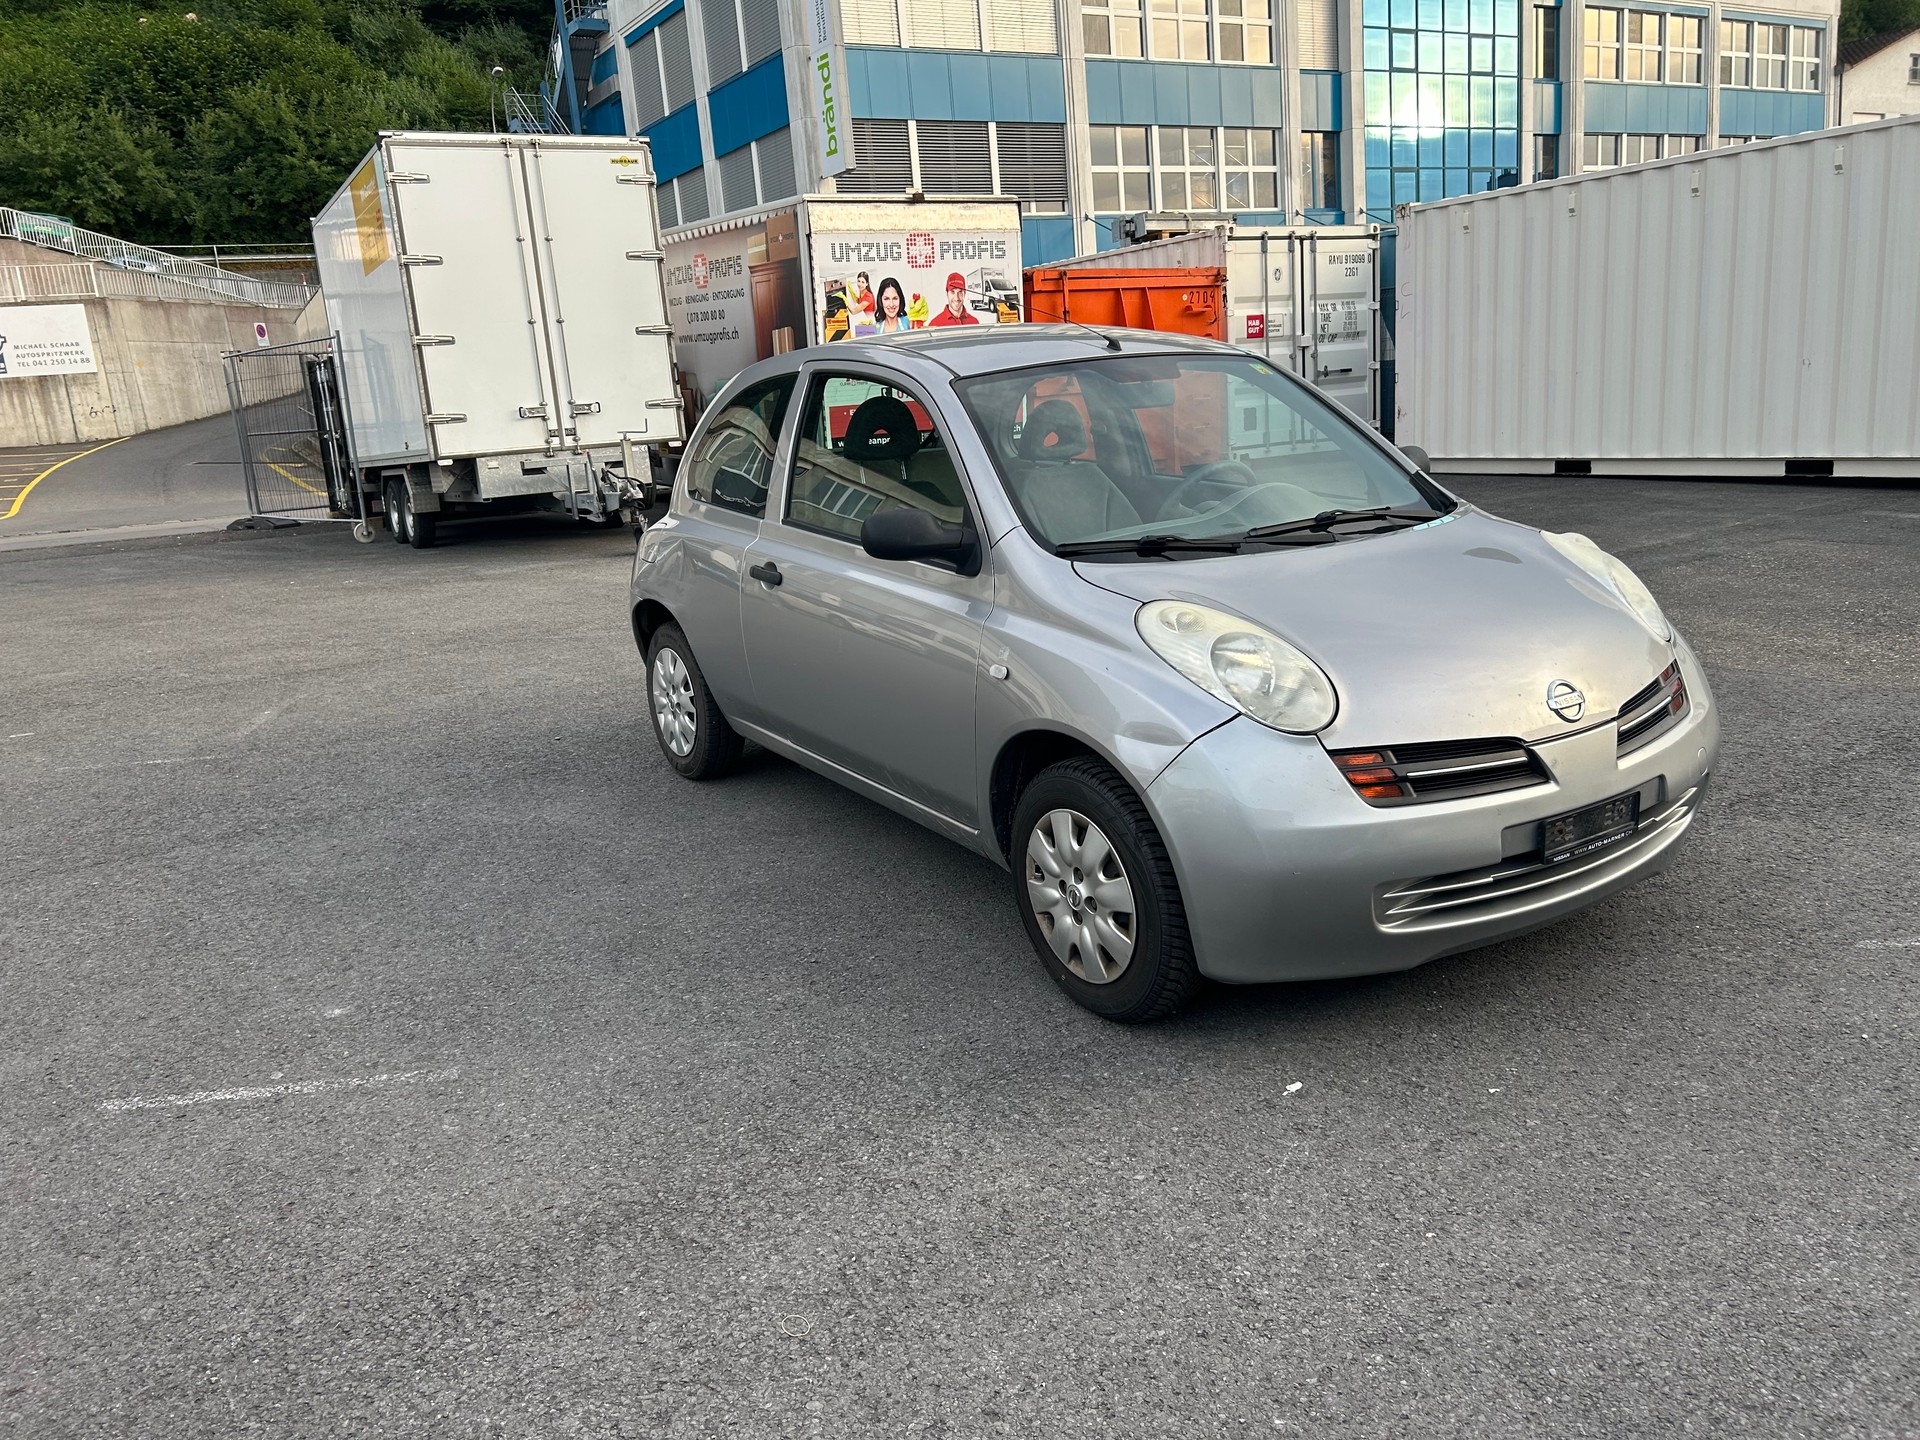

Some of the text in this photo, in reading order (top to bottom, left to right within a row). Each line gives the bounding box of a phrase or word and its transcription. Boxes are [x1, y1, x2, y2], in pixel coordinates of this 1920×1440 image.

[817, 52, 839, 158] brändi
[830, 240, 1006, 262] UMZUG PROFIS
[709, 255, 743, 279] PROFIS
[685, 293, 710, 305] REINIGUNG
[712, 287, 745, 301] ENTSORGUNG
[1189, 290, 1215, 304] 2704
[1247, 319, 1260, 327] HAB
[679, 326, 740, 345] www.umzugprofis.ch
[15, 350, 85, 358] AUTOSPRITZWERK
[32, 359, 48, 367] 041
[50, 358, 66, 366] 250
[1554, 692, 1584, 707] NISSAN
[1553, 852, 1571, 862] NISSAN
